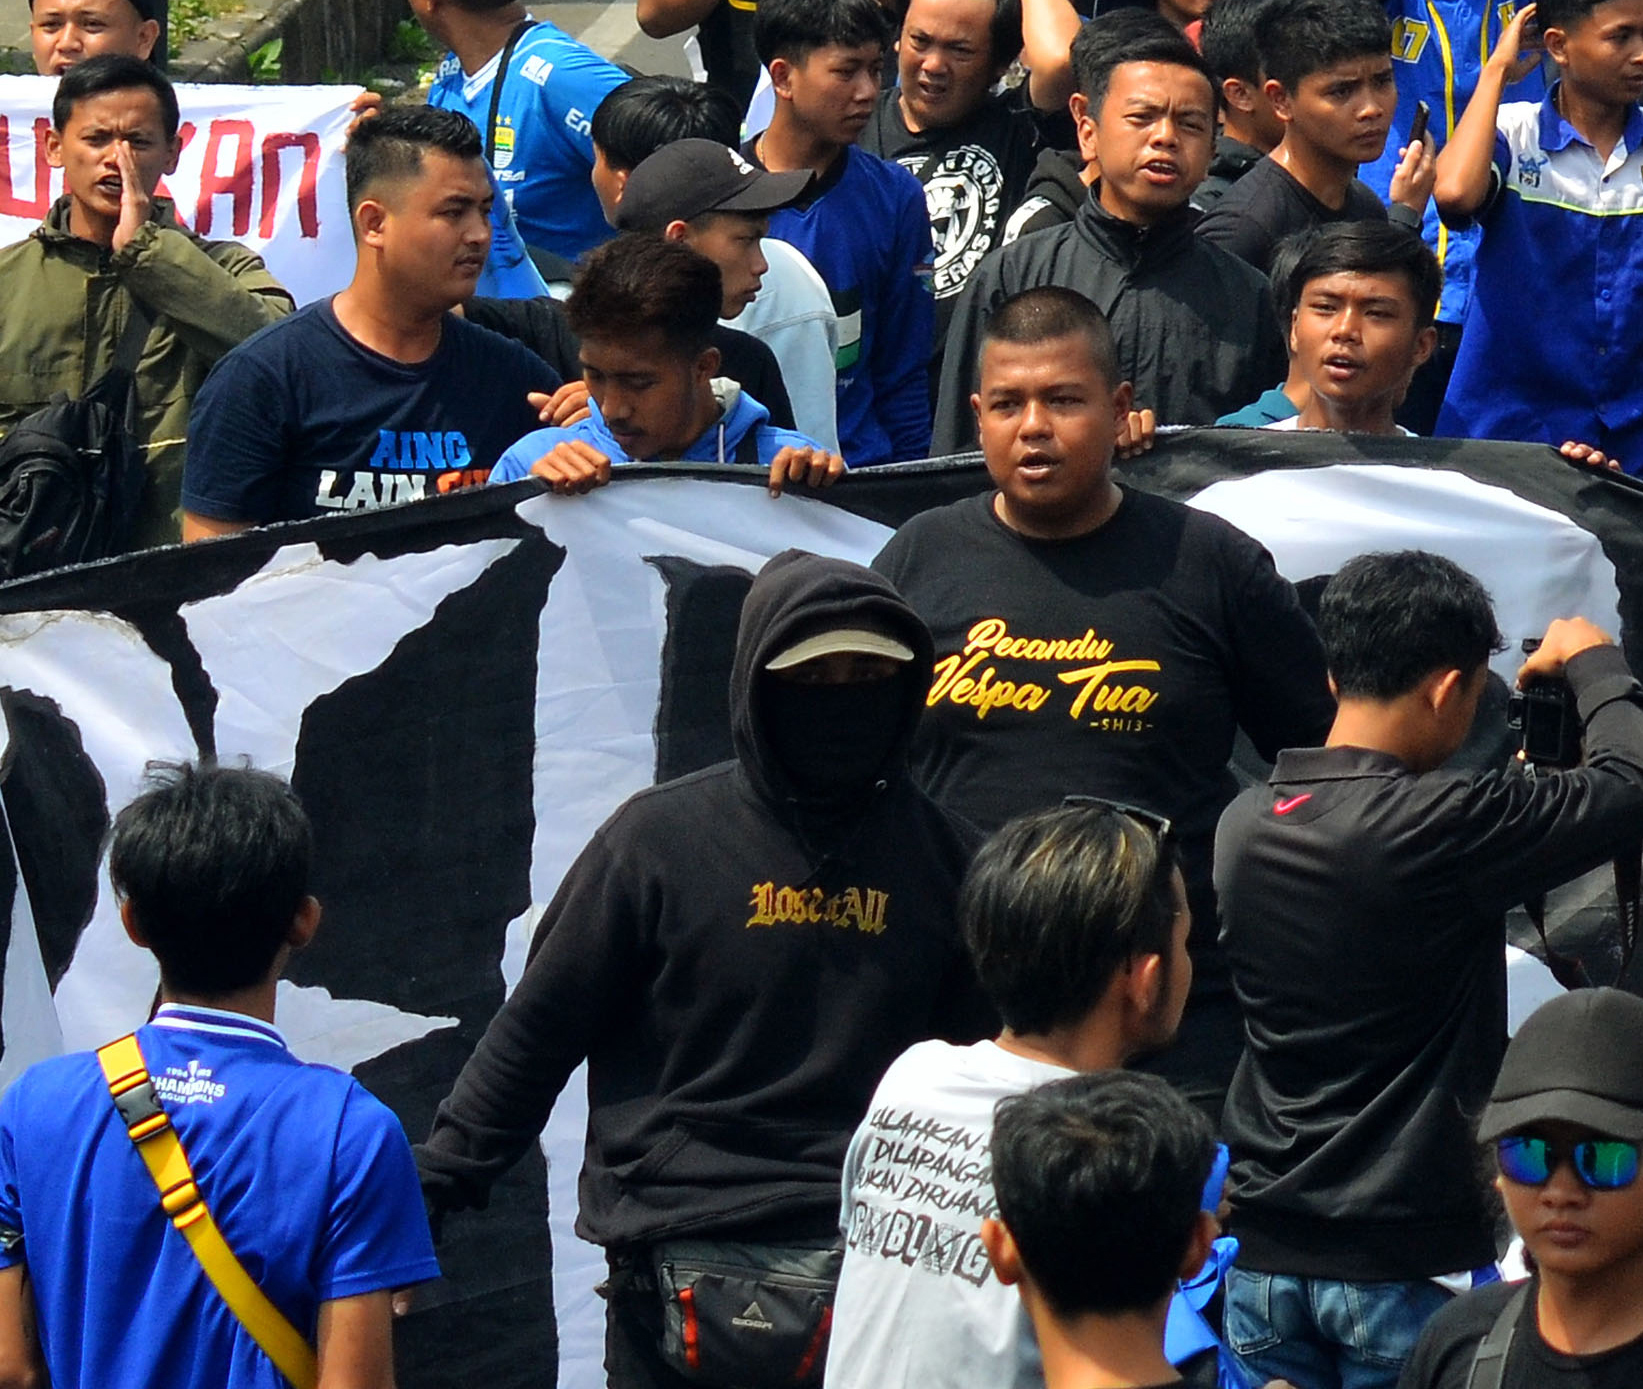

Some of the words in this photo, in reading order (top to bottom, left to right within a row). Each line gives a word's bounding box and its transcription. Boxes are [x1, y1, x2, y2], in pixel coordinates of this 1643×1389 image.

[370, 430, 472, 470] AING
[316, 468, 427, 511] LAIN
[964, 618, 1115, 660] Pecandu
[926, 649, 1052, 720] Vespa
[1057, 660, 1161, 720] Tua
[870, 1106, 985, 1152] ALAHKAN
[873, 1137, 994, 1187] DILAPANGA
[896, 1176, 1000, 1220] DIRUAN
